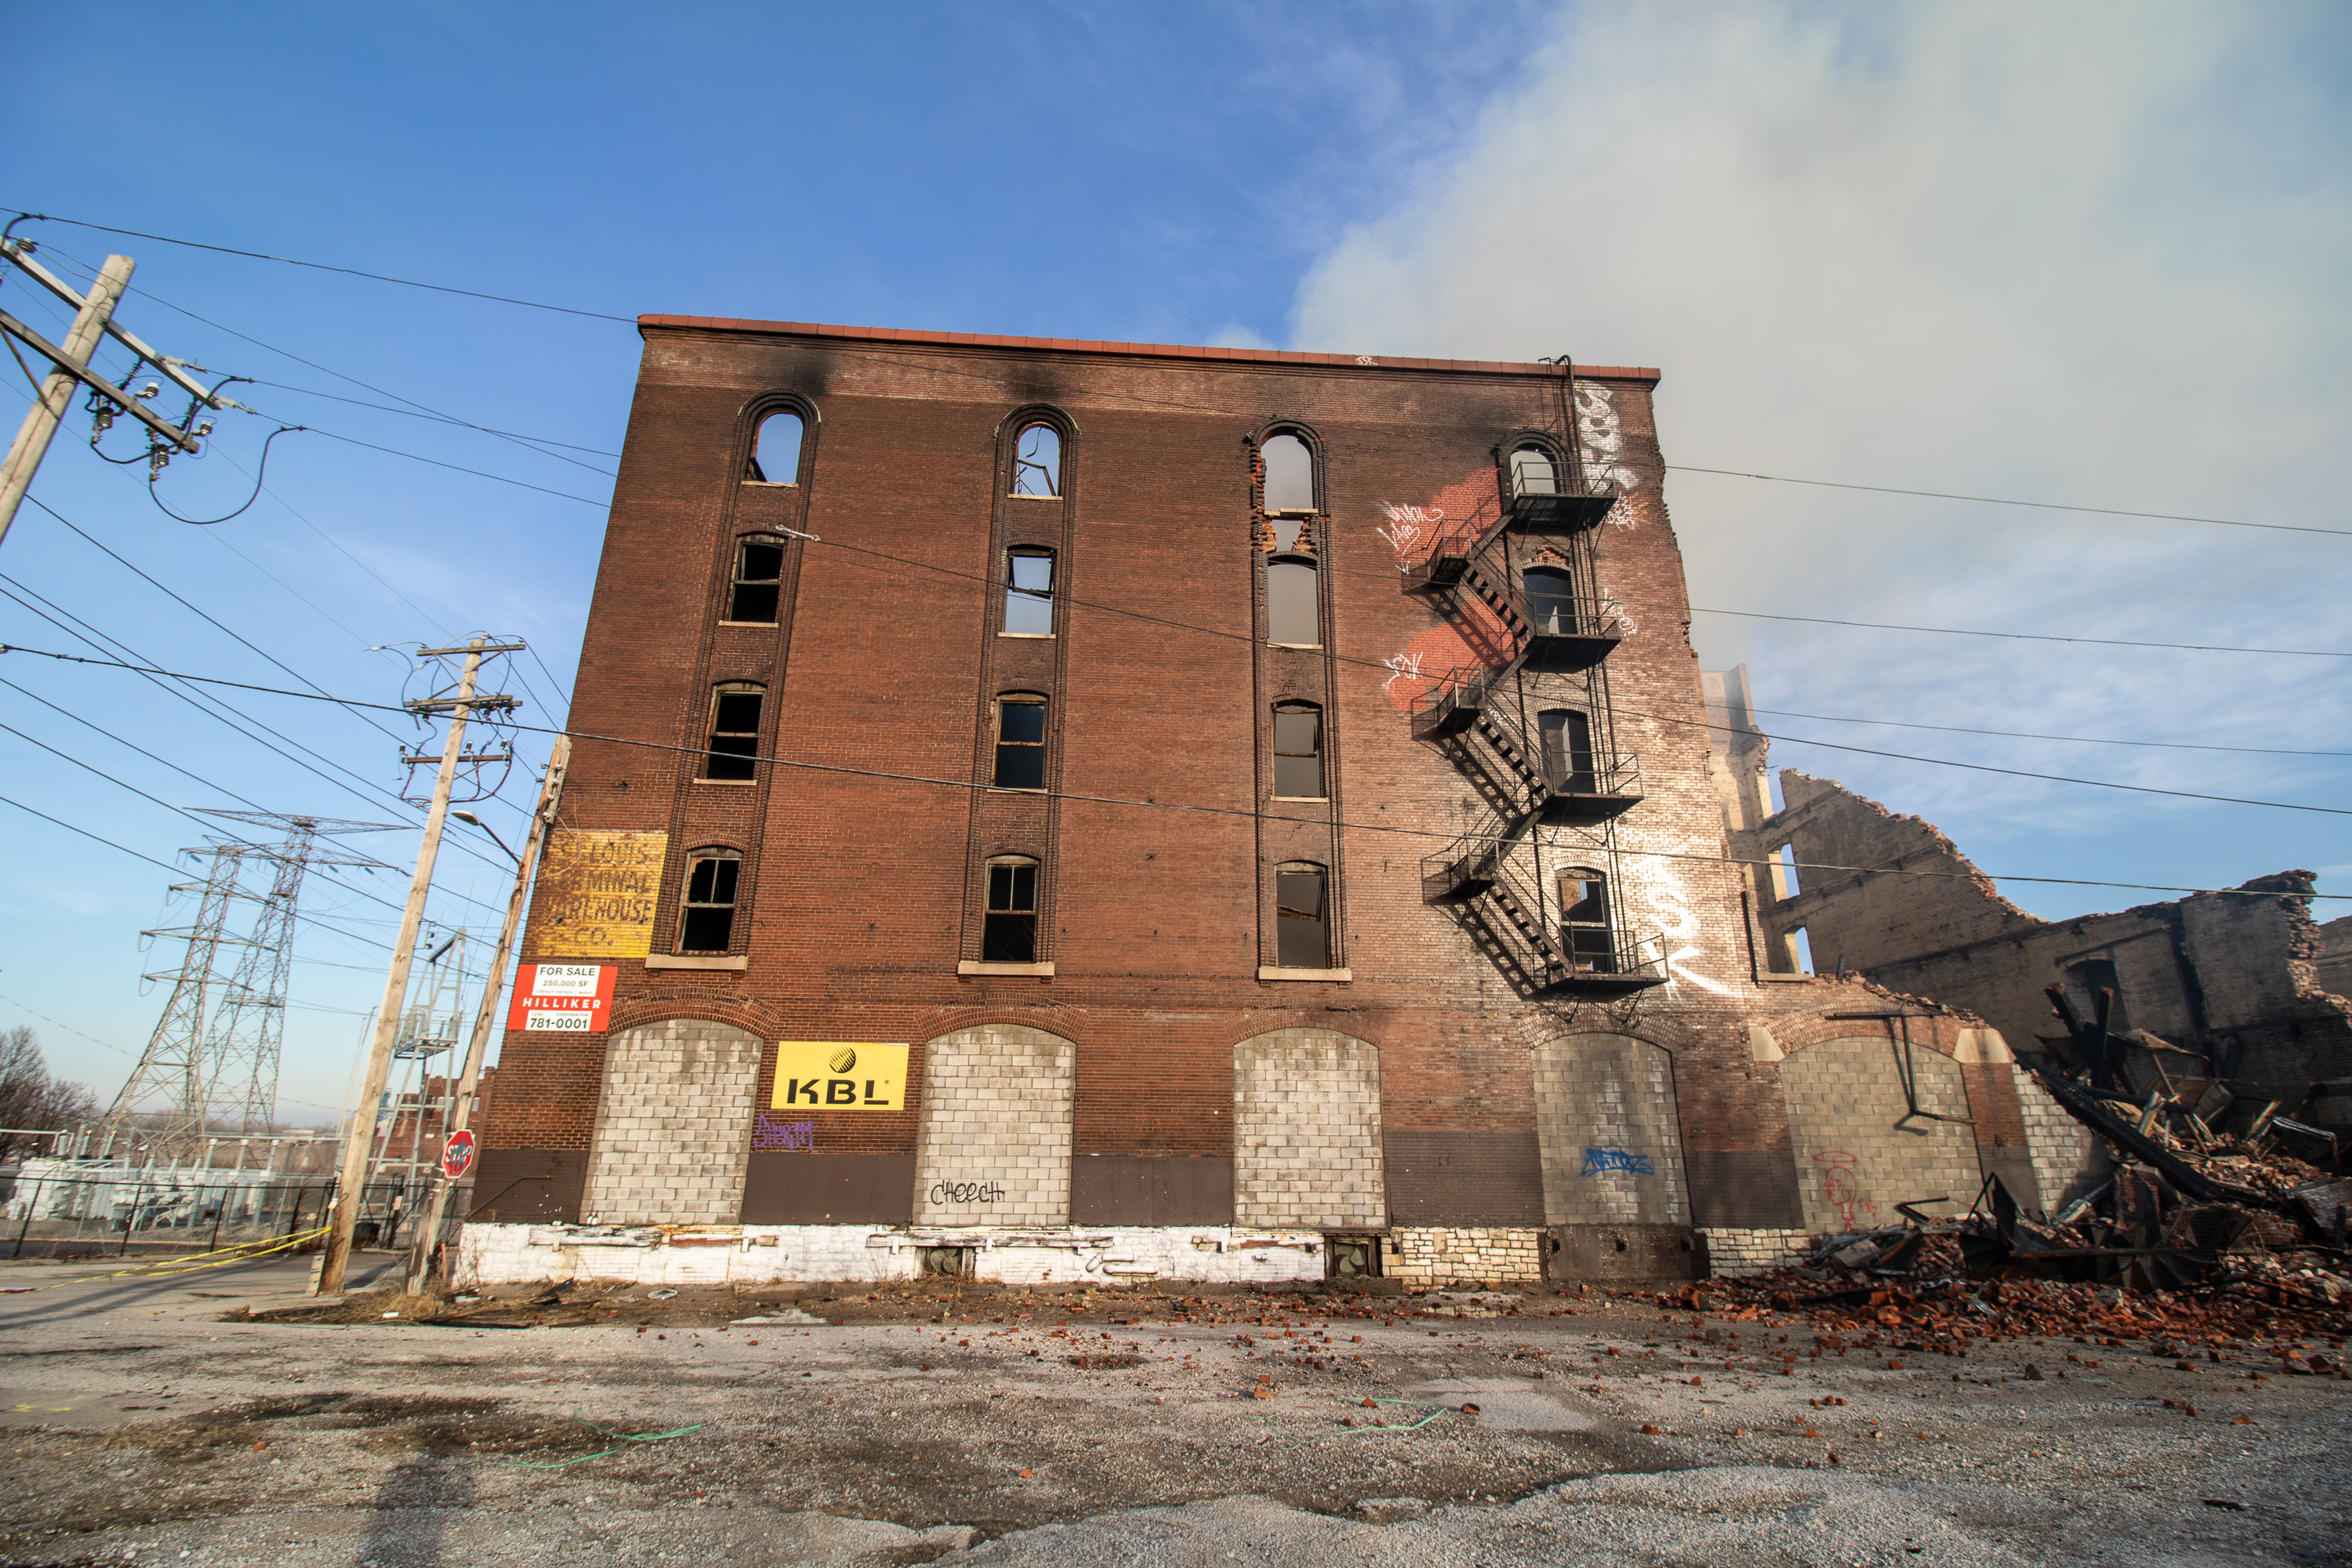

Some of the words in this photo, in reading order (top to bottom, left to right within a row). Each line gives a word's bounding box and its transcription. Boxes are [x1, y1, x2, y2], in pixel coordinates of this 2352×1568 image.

[539, 967, 563, 975] FOR
[566, 967, 596, 976] SALE
[522, 997, 601, 1009] HILLIKER
[530, 1018, 588, 1029] 781-0001
[786, 1078, 890, 1105] KBL
